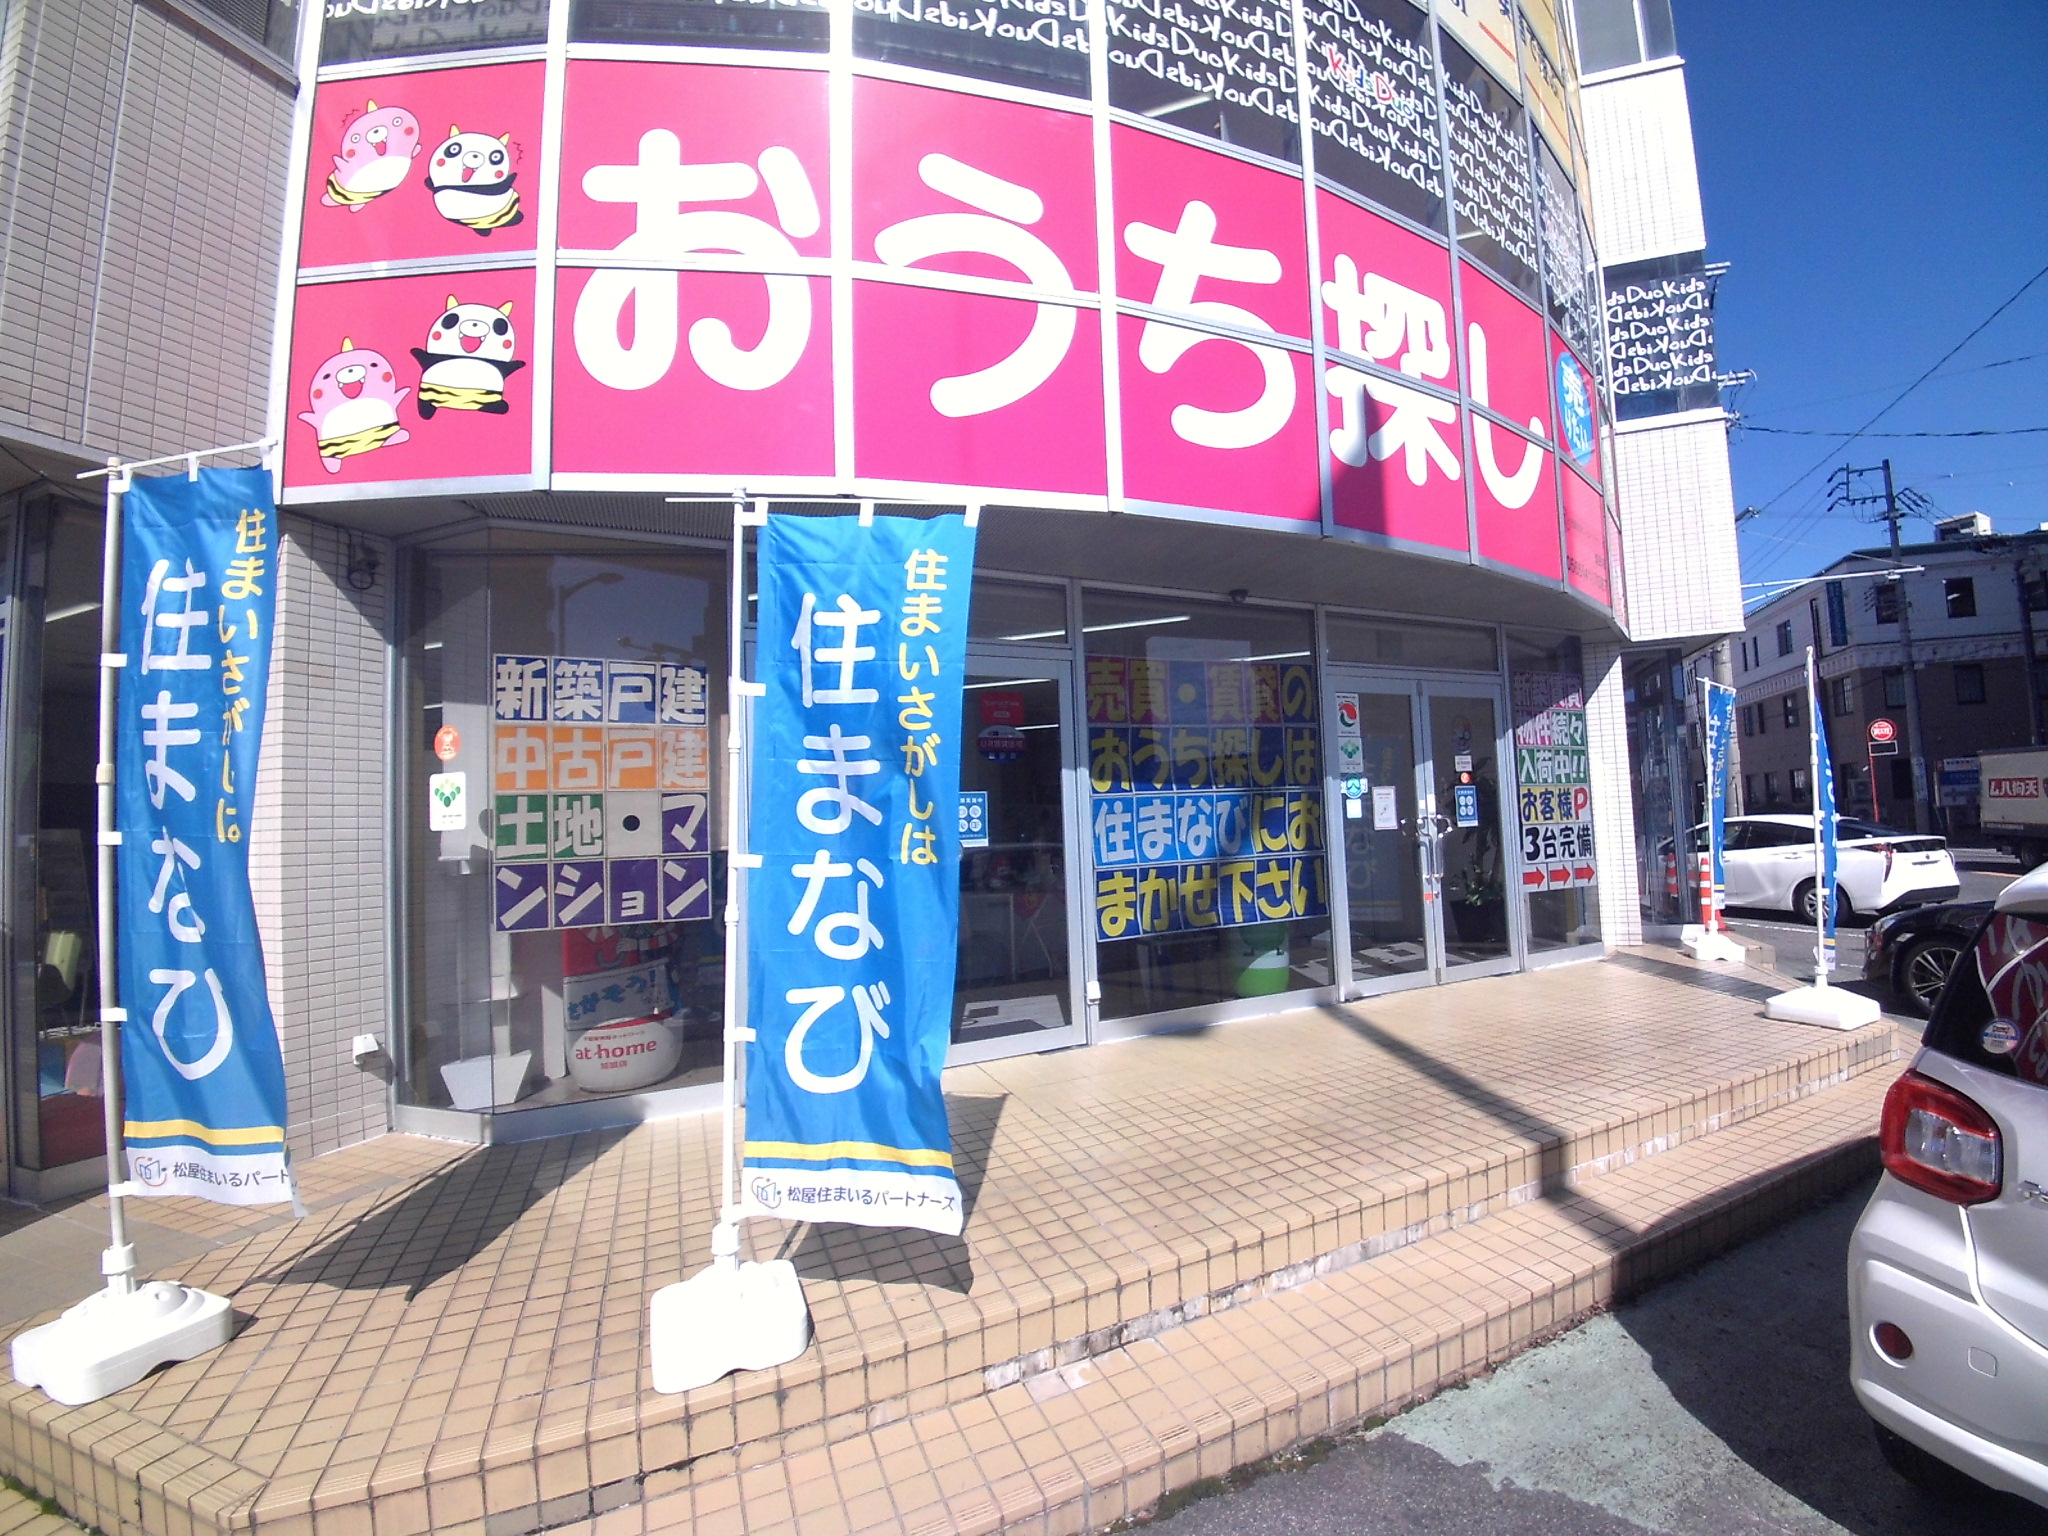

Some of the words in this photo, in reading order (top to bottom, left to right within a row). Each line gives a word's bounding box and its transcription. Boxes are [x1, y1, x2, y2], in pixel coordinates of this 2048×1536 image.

[574, 127, 1545, 509] おうち探し
[496, 657, 706, 725] 新築戸建
[897, 548, 949, 866] 住まいさがしは
[1086, 656, 1313, 722] 売買・賃貸の
[498, 727, 708, 790] 中古戸建
[1090, 727, 1317, 793] おうち探しは
[784, 592, 892, 1094] 住まなび
[1094, 797, 1321, 863] 住まなびにお
[1525, 825, 1592, 862] 3台完備
[1097, 859, 1325, 937] まかせ下さい
